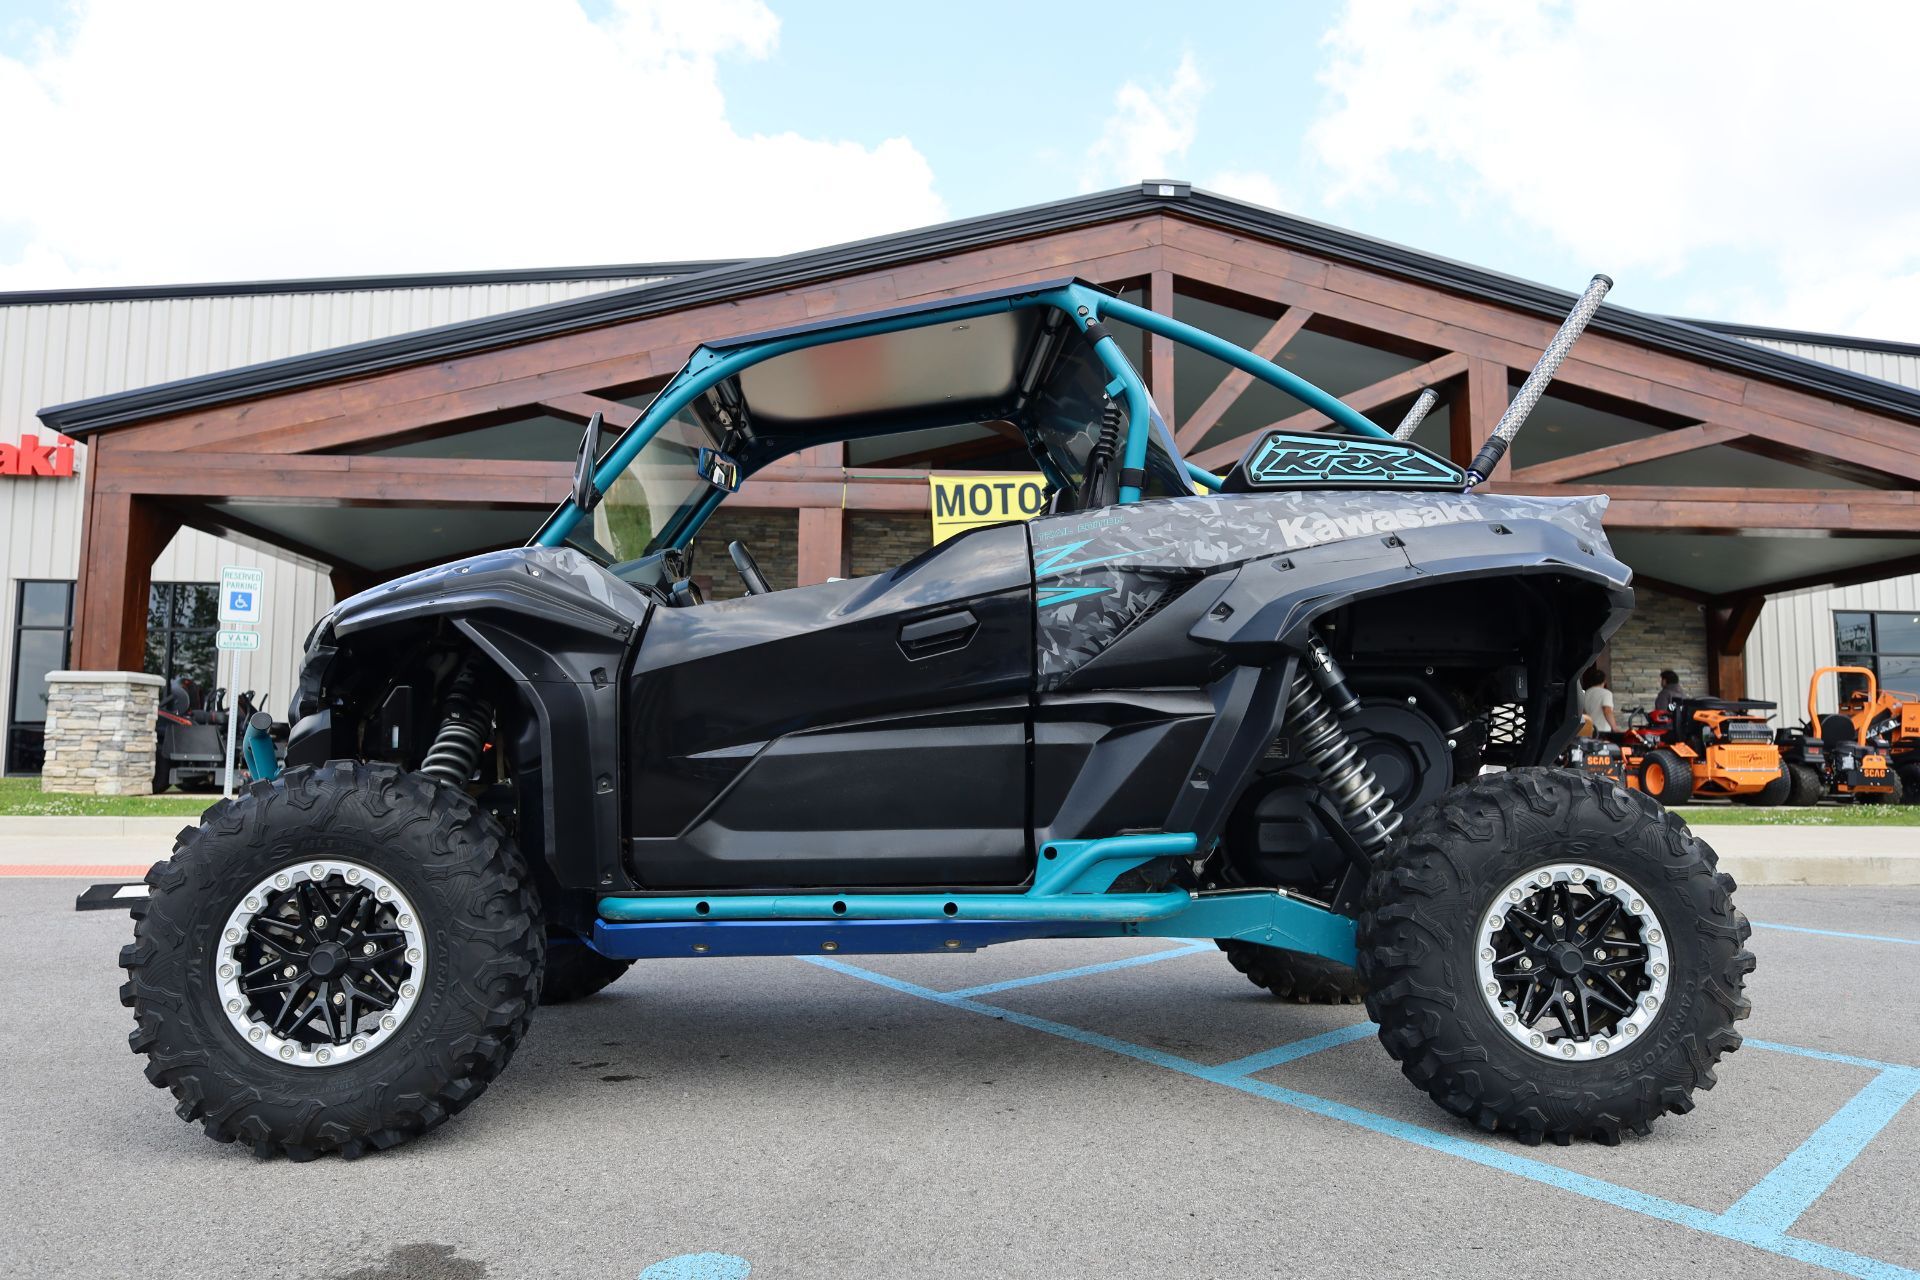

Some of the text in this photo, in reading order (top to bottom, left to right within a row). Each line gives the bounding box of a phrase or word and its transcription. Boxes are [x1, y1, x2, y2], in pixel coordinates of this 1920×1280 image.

[1265, 448, 1430, 474] KRX
[935, 482, 1041, 517] MOTO
[1277, 499, 1485, 547] Kawasaki
[224, 571, 261, 581] RESERVED
[226, 581, 258, 590] PARKING
[228, 634, 249, 642] VAN
[1587, 756, 1610, 765] SCAG
[1864, 769, 1886, 777] SCAG
[1614, 980, 1697, 1079] CARNIVORE
